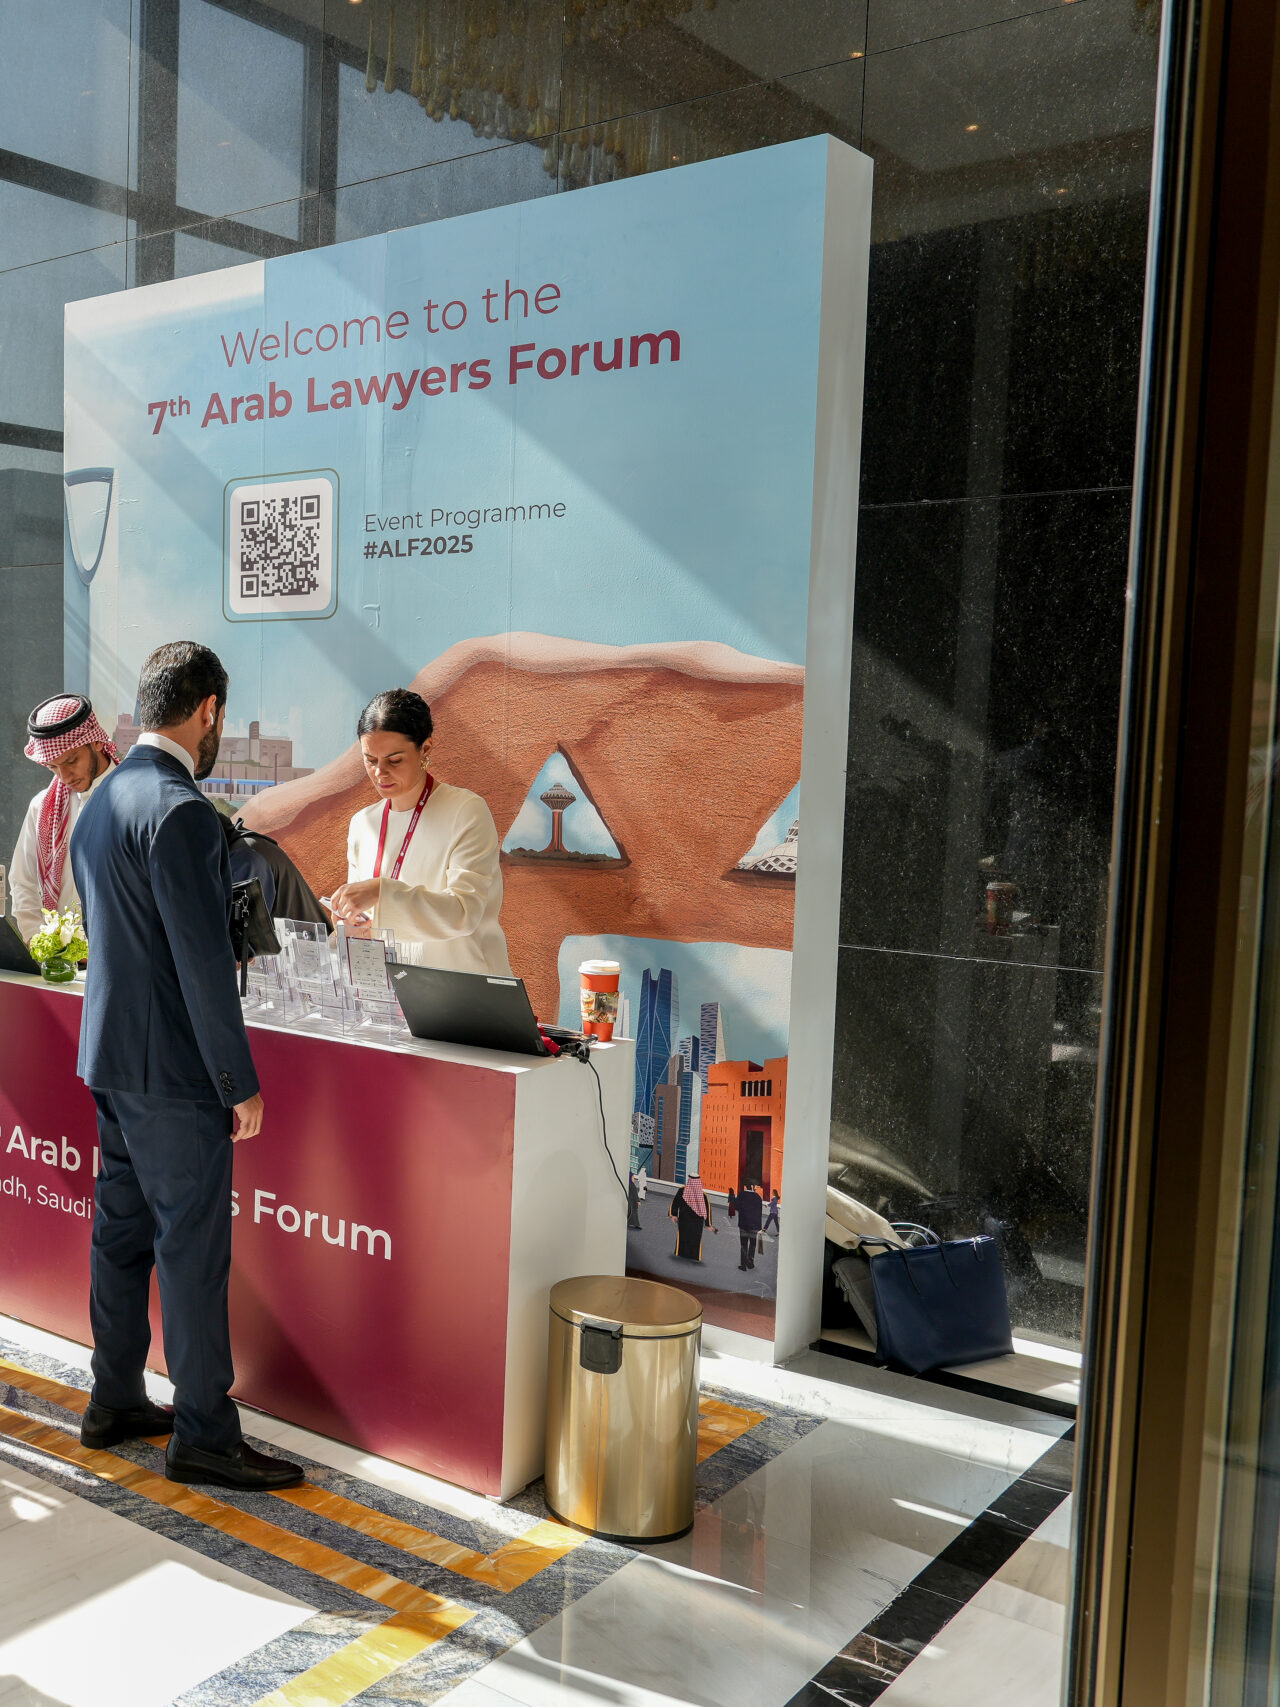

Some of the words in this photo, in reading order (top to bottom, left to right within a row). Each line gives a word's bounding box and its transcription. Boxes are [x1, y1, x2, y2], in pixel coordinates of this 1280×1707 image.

[220, 310, 410, 368] Welcome
[423, 299, 468, 334] to
[481, 279, 561, 323] the
[147, 395, 191, 435] 7th
[200, 381, 293, 428] Arab
[307, 358, 492, 411] Lawyers
[508, 329, 681, 385] Forum
[364, 511, 424, 533] Event
[430, 502, 567, 530] Programme
[363, 534, 475, 560] #ALF2025
[5, 1125, 82, 1172] Arab
[36, 1184, 93, 1220] Saudi
[253, 1188, 393, 1261] Forum
